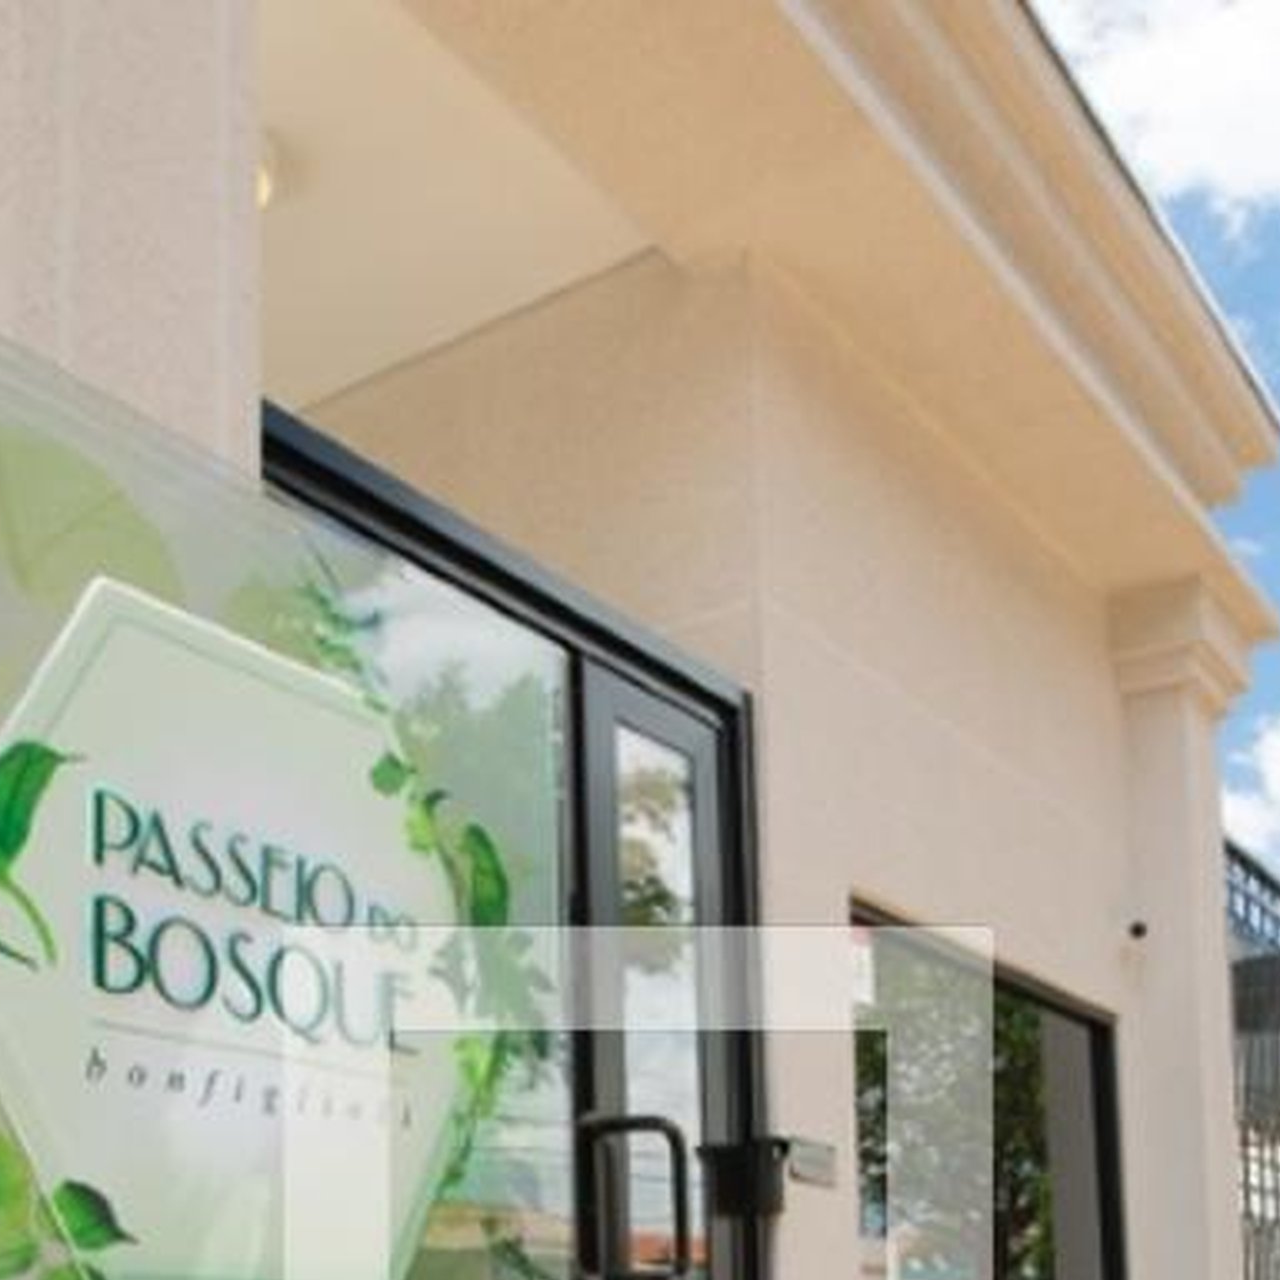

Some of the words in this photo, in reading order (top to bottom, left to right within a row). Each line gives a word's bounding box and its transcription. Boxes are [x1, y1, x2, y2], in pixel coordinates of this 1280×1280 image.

[93, 788, 355, 929] PASSEIO
[90, 894, 422, 1055] BOSQUE
[84, 1043, 414, 1130] bonfiglioi
